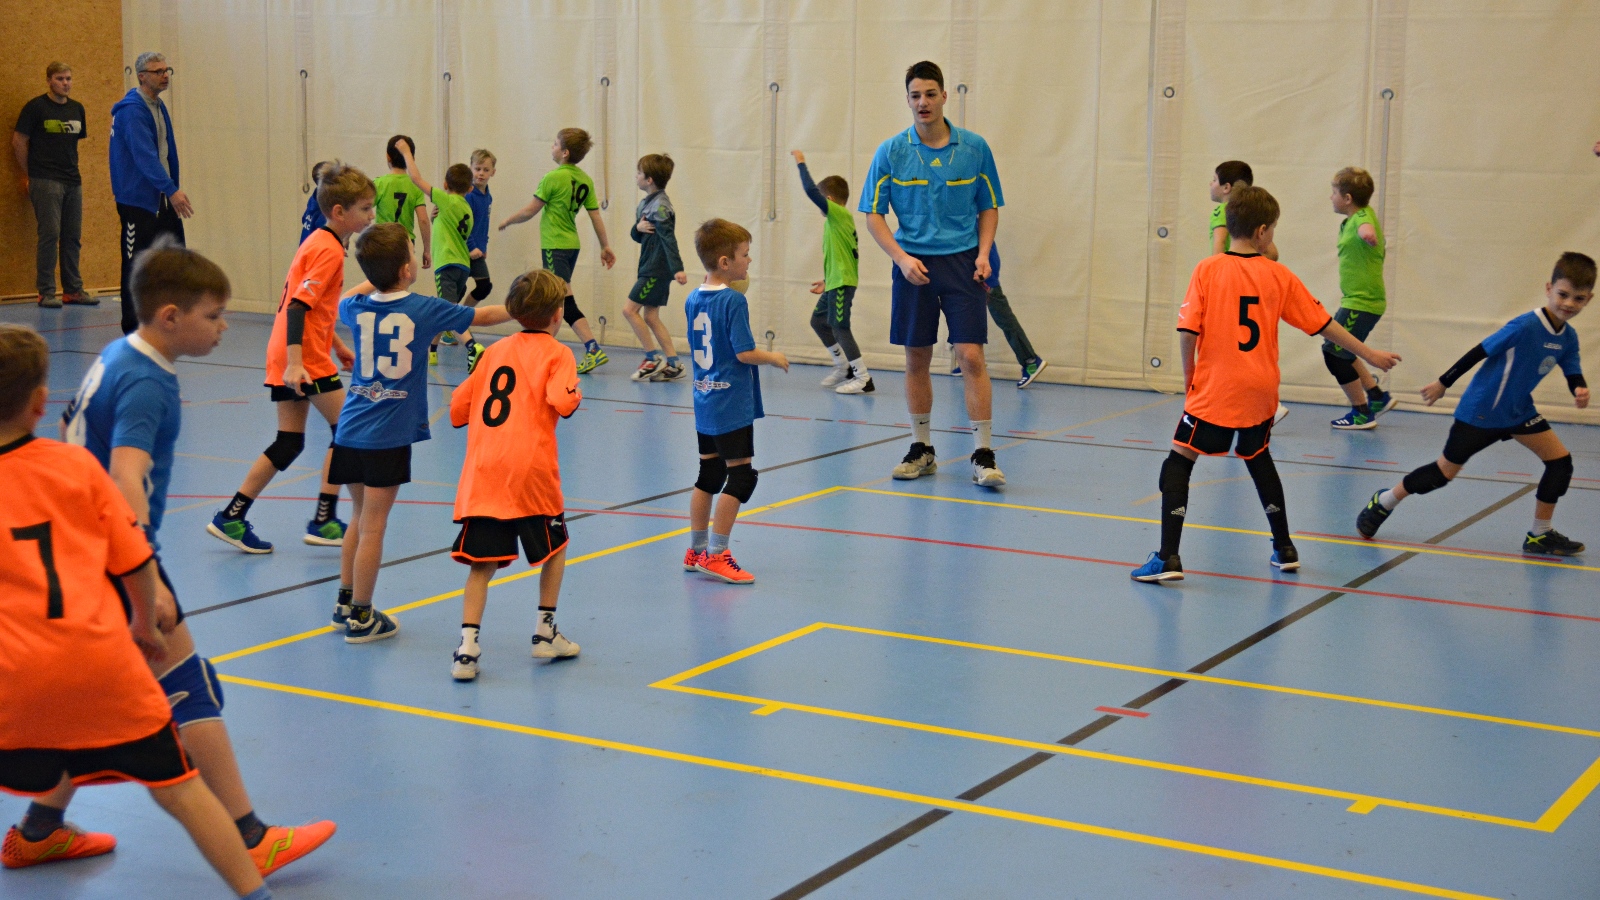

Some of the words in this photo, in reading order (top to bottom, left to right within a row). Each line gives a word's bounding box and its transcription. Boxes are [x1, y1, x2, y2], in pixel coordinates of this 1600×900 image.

[393, 192, 408, 222] 7
[356, 311, 416, 380] 13
[693, 311, 714, 371] 3
[1238, 295, 1261, 353] 5
[482, 365, 517, 428] 8
[9, 520, 64, 620] 7
